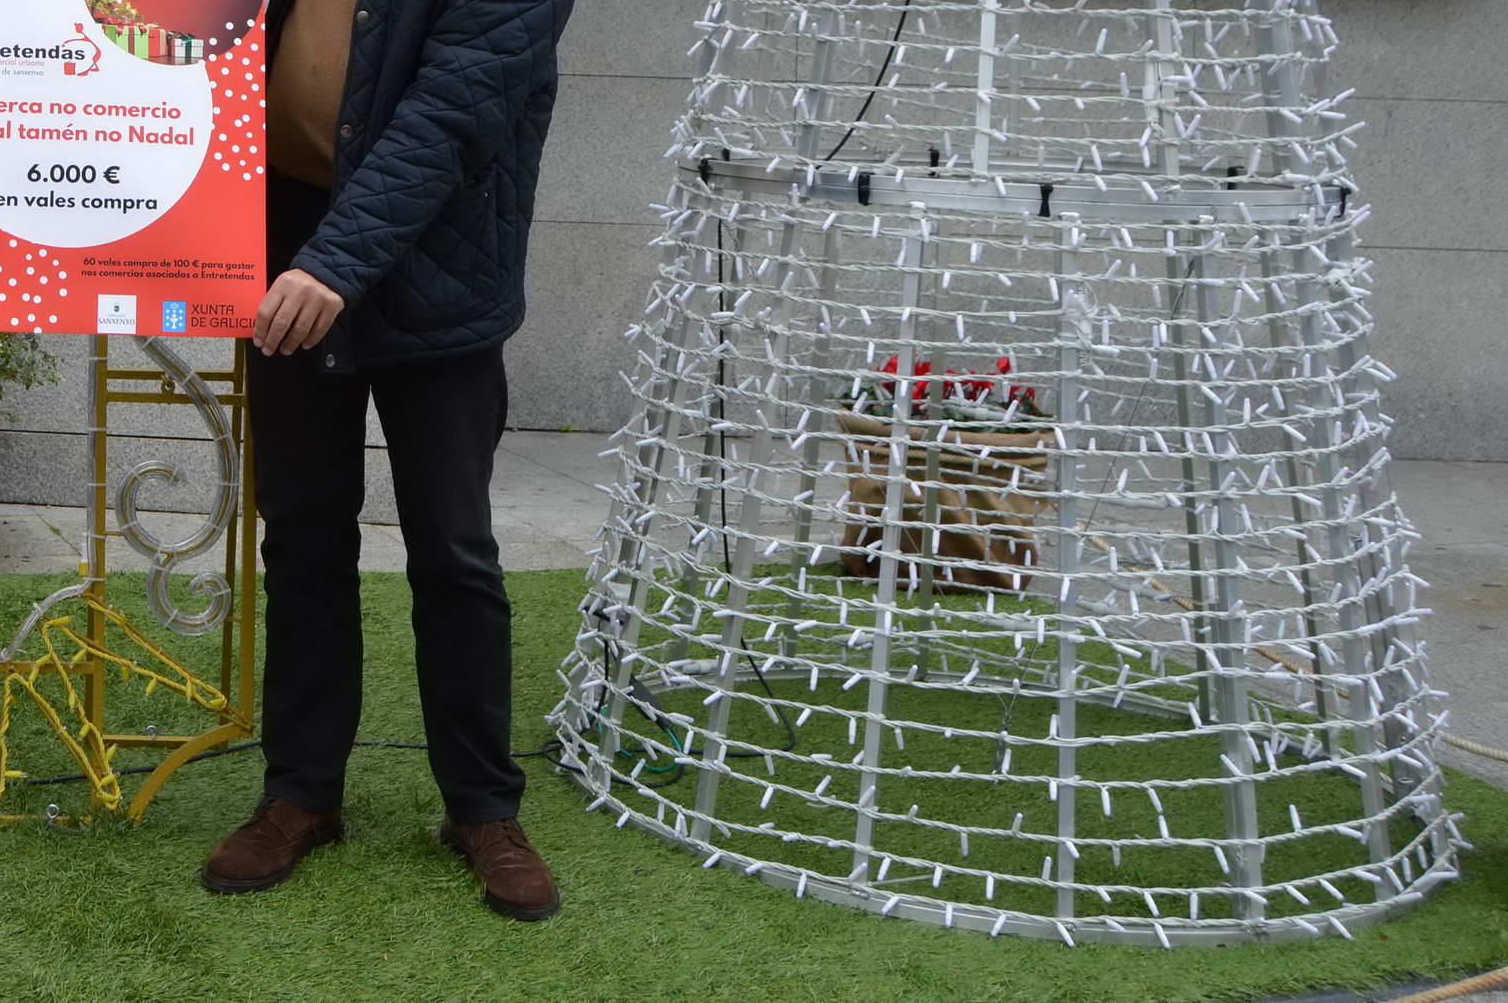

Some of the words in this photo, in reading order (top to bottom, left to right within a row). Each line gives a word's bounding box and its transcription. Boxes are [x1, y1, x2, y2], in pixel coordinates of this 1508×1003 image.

[1, 68, 11, 76] de
[49, 101, 77, 115] no
[82, 101, 182, 120] comercio
[18, 123, 88, 141] tamén
[94, 128, 122, 143] no
[128, 125, 194, 145] Nadal
[27, 163, 97, 184] 6.000
[103, 165, 121, 185] €
[24, 190, 76, 209] vales
[81, 196, 158, 214] compra
[83, 258, 96, 266] 60
[97, 257, 122, 267] vales
[123, 260, 158, 270] compra
[160, 259, 172, 268] de
[173, 259, 190, 268] 100
[192, 260, 200, 268] €
[201, 262, 224, 271] para
[225, 262, 255, 272] gastar
[81, 269, 97, 277] nos
[98, 269, 144, 278] comercios
[145, 270, 190, 279] asociados
[200, 271, 255, 280] Entretendas
[191, 304, 235, 315] XUNTA
[190, 317, 206, 327] DE
